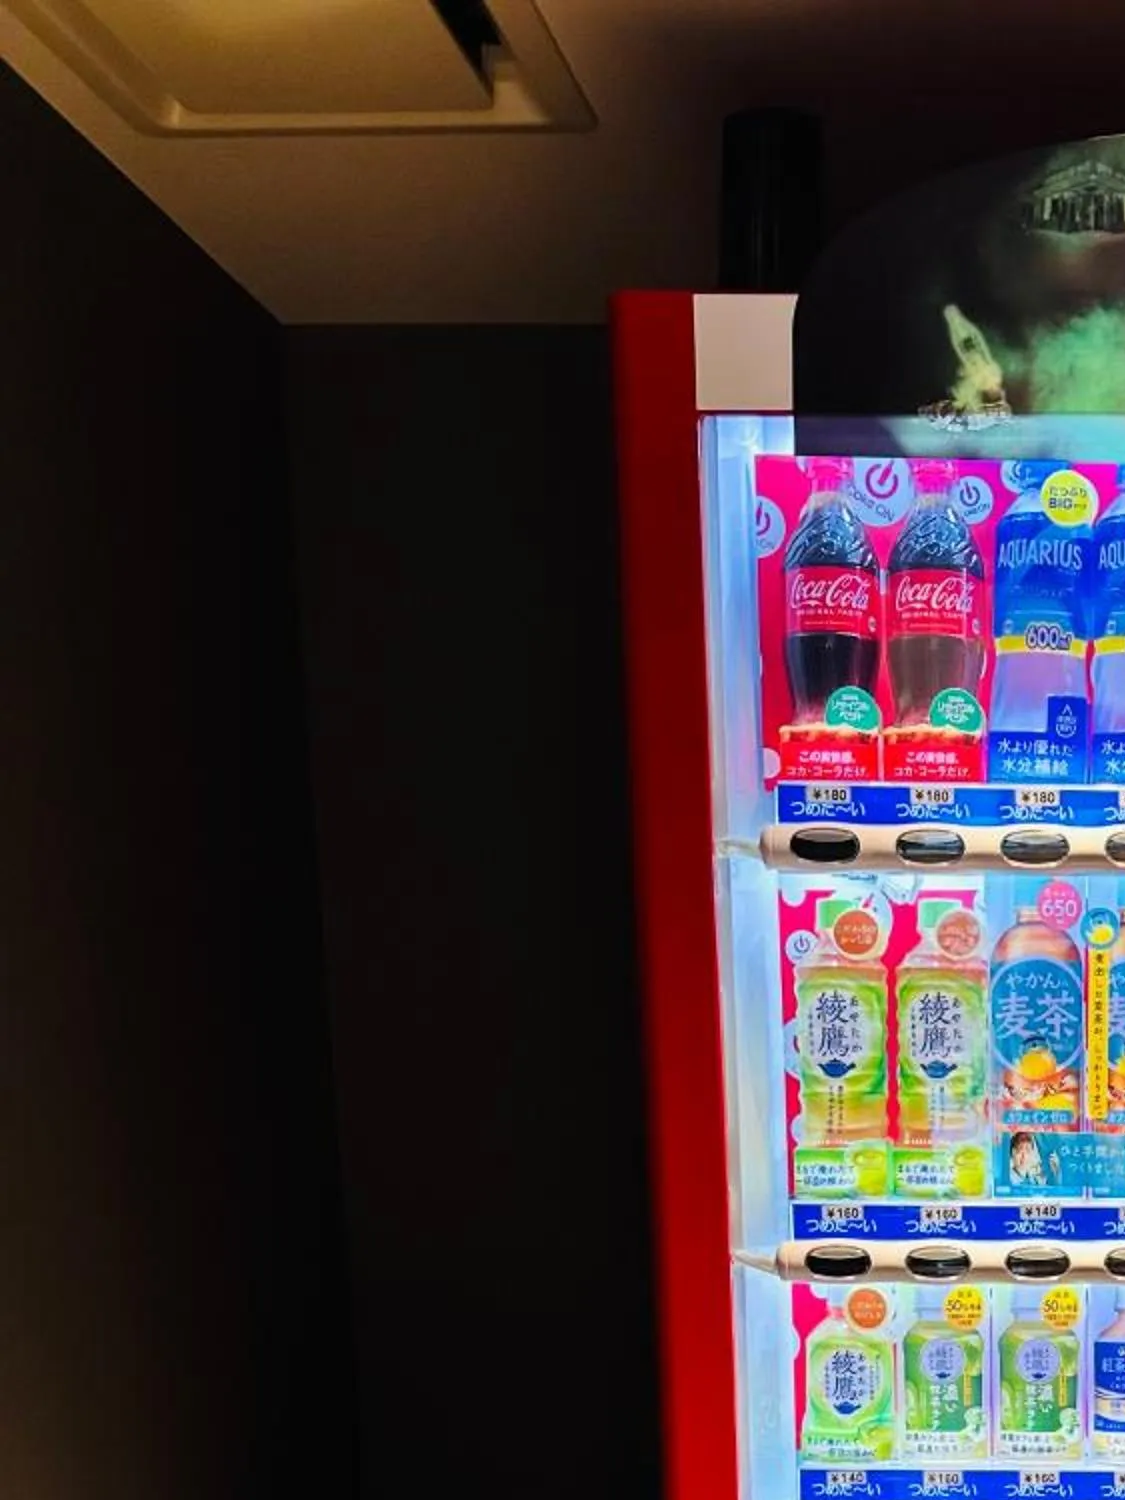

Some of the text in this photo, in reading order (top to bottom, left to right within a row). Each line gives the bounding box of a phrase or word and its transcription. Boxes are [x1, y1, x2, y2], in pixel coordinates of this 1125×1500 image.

[997, 539, 1083, 571] AQUARIUS
[790, 572, 872, 611] Coca-Cola
[895, 575, 975, 614] Coca-Cola
[997, 738, 1073, 757] 水より優れた
[1002, 757, 1069, 776] 水分補給
[812, 788, 847, 801] ¥180
[916, 790, 949, 802] ¥180
[1021, 791, 1055, 803] ¥180
[1041, 901, 1078, 917] 650
[995, 991, 1079, 1040] 麦茶
[1024, 1208, 1057, 1217] ¥140
